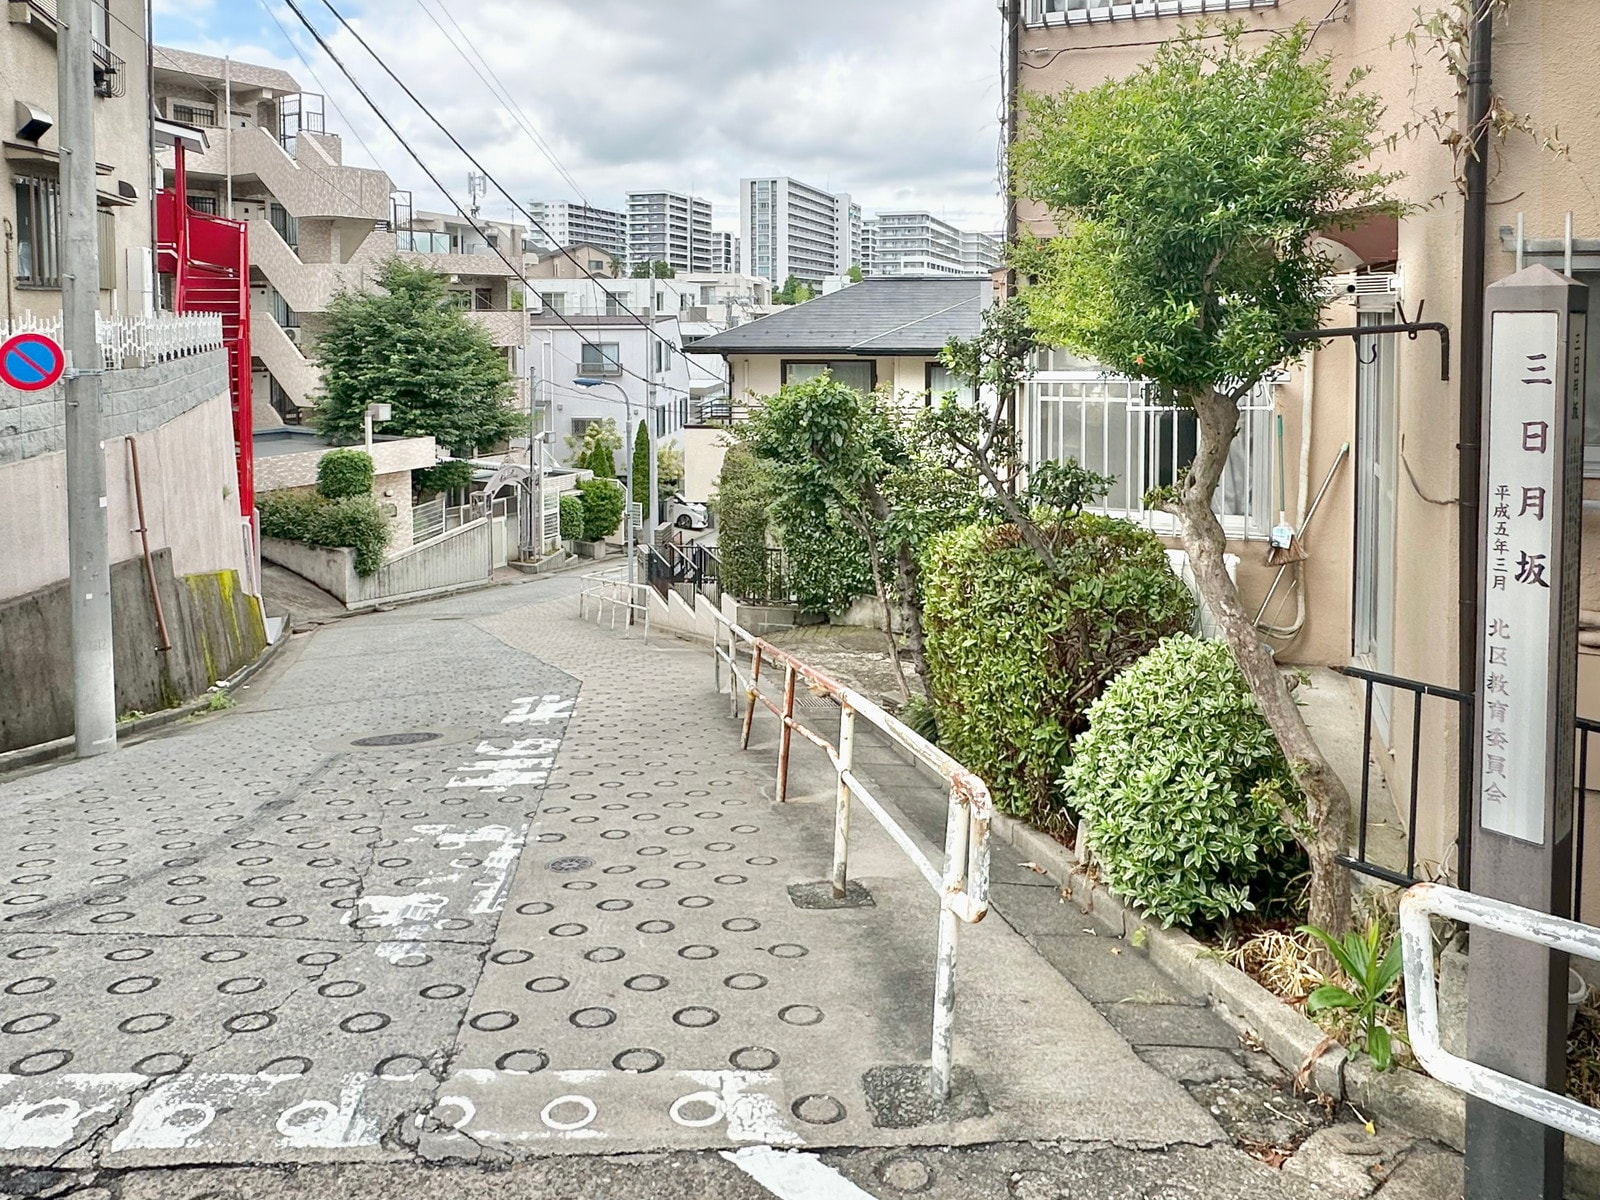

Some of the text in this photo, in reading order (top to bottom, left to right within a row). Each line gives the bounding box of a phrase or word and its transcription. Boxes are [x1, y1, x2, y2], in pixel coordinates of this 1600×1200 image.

[1514, 353, 1552, 588] 三日月坂
[1483, 485, 1511, 805] 平成五年三月 北区教育委員会
